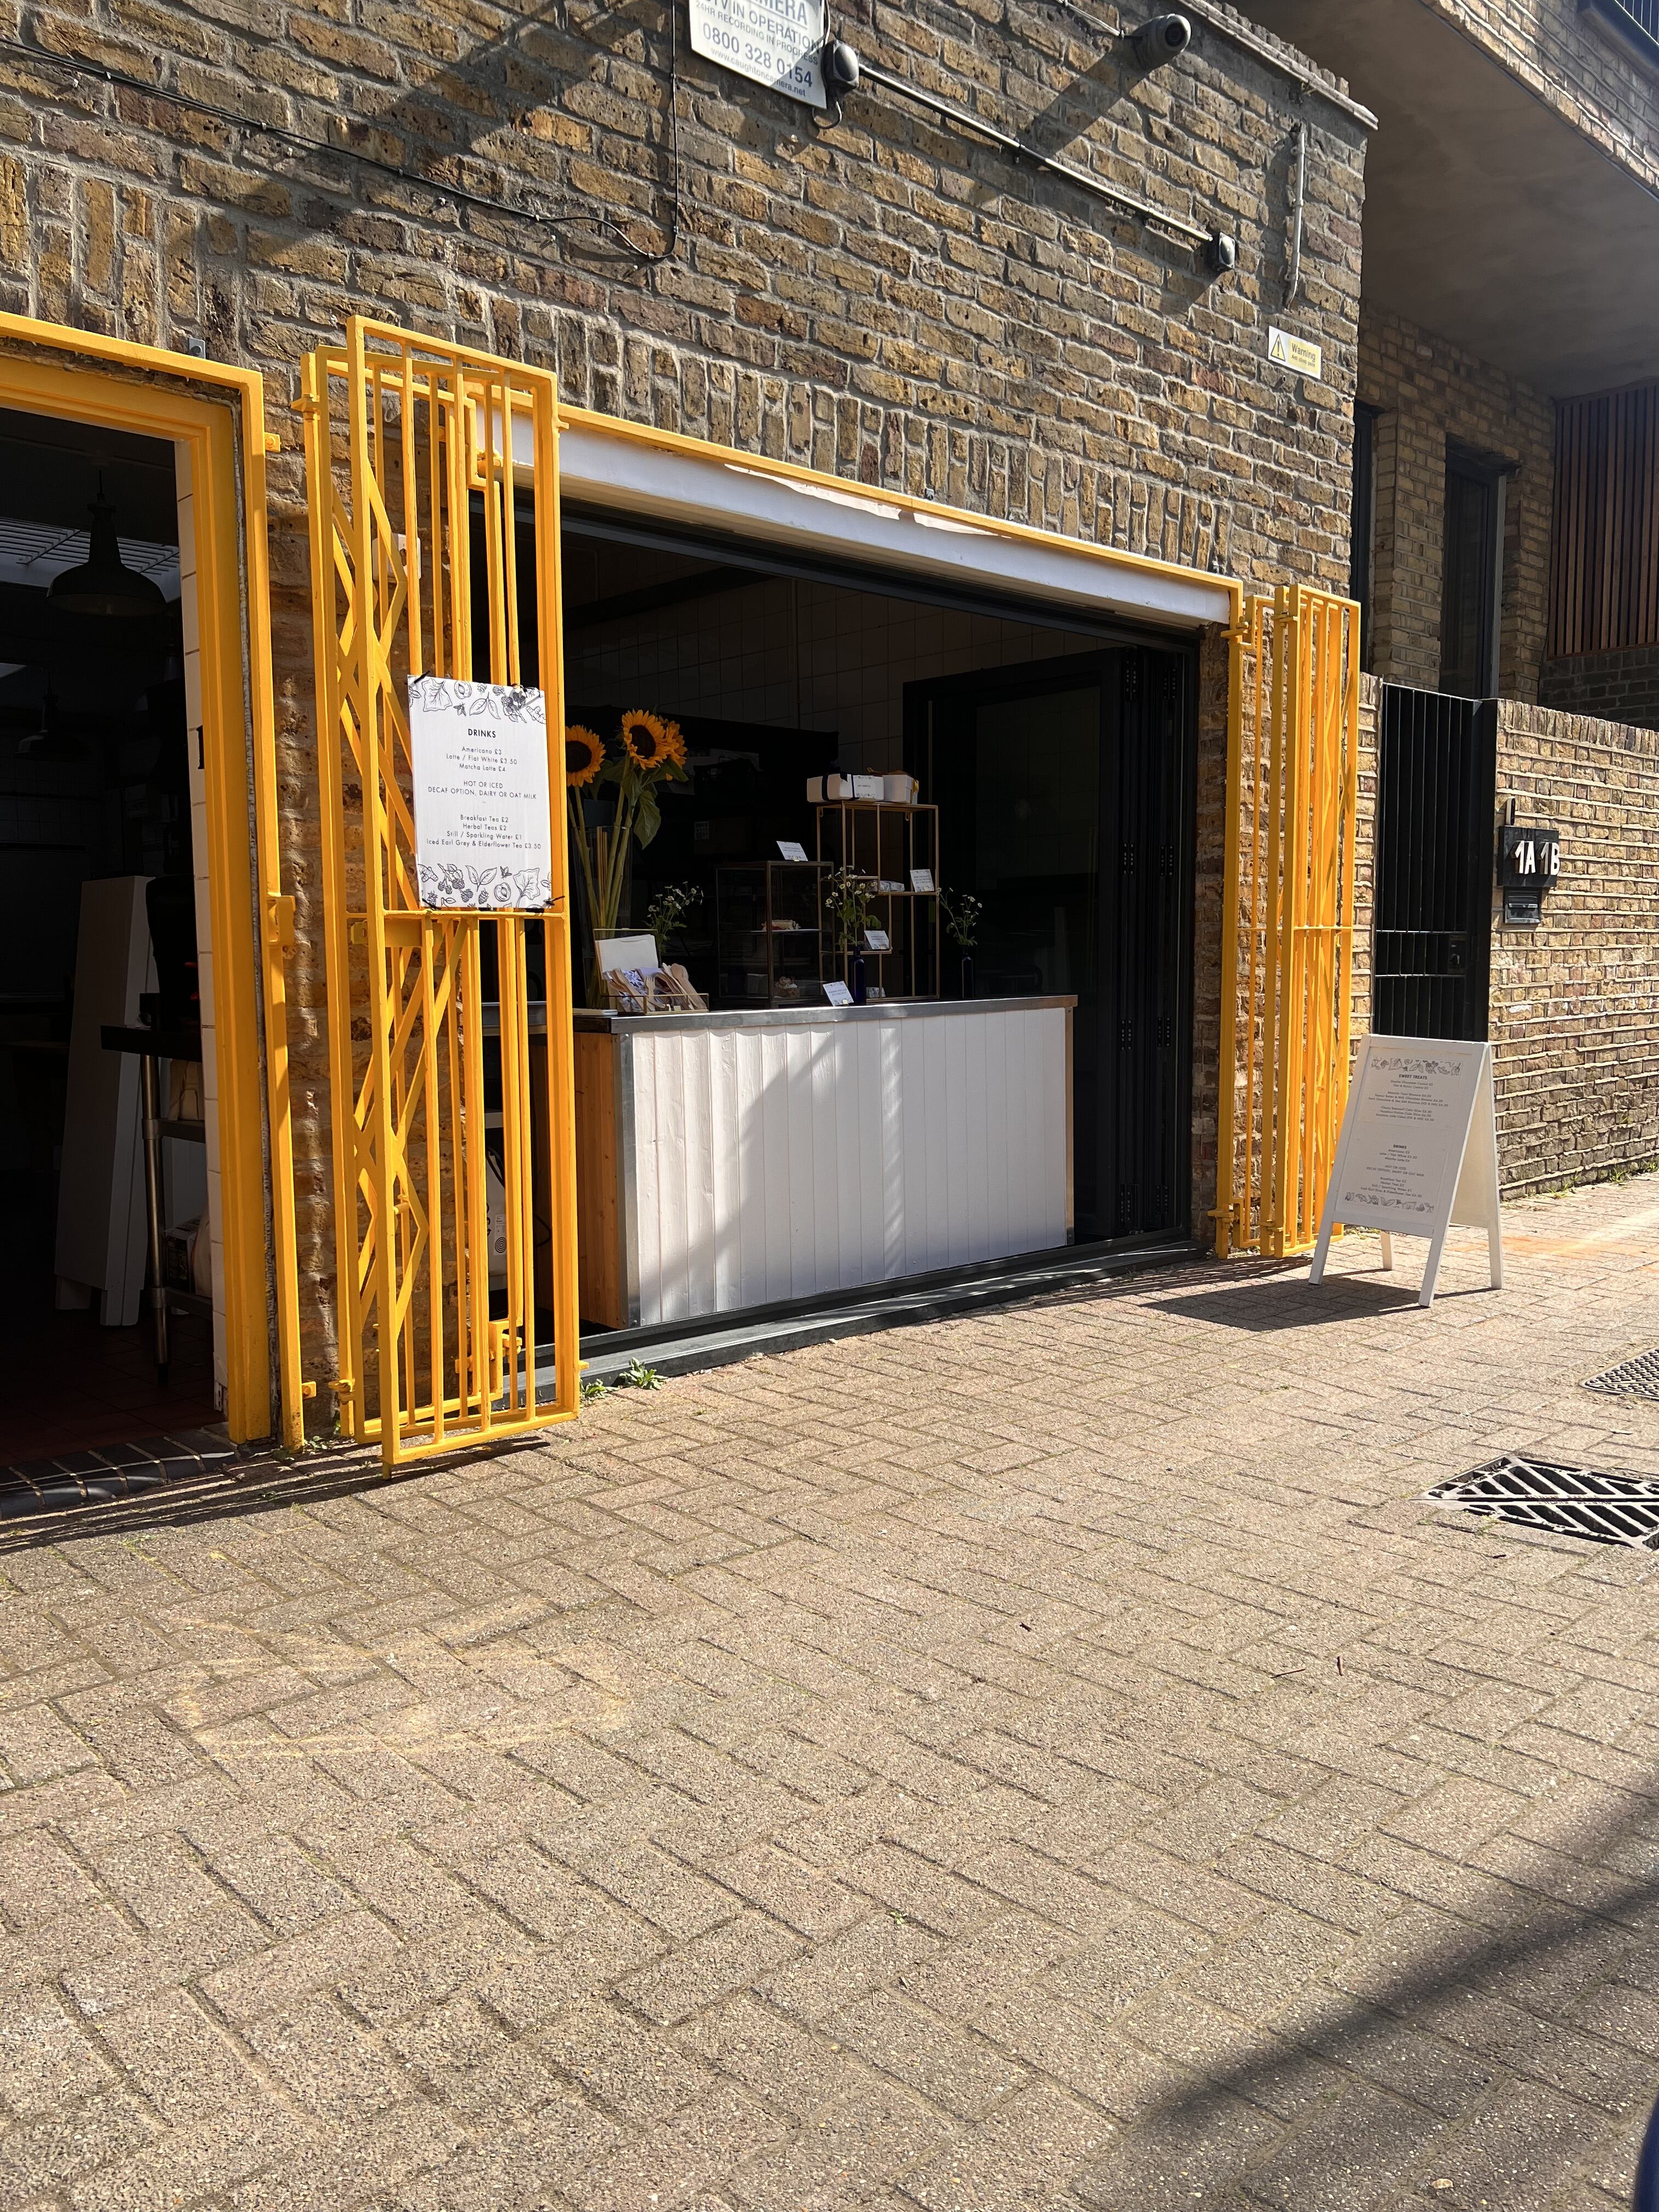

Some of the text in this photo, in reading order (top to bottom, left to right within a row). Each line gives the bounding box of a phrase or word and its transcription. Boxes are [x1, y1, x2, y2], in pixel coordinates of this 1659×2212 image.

[718, 11, 764, 40] RECORDING
[766, 34, 774, 45] IN
[776, 39, 818, 65] PROGRESS
[733, 1, 819, 54] IN OPERATION
[703, 22, 812, 88] 0800 328 0154
[711, 48, 805, 97] www.caughtoncamera.net
[1291, 343, 1316, 363] Warning
[468, 729, 496, 738] DRINKS
[462, 746, 492, 754] Americano
[450, 788, 477, 796] OPTION,
[466, 832, 494, 840] Sparkling
[1515, 840, 1560, 876] 1A 1B
